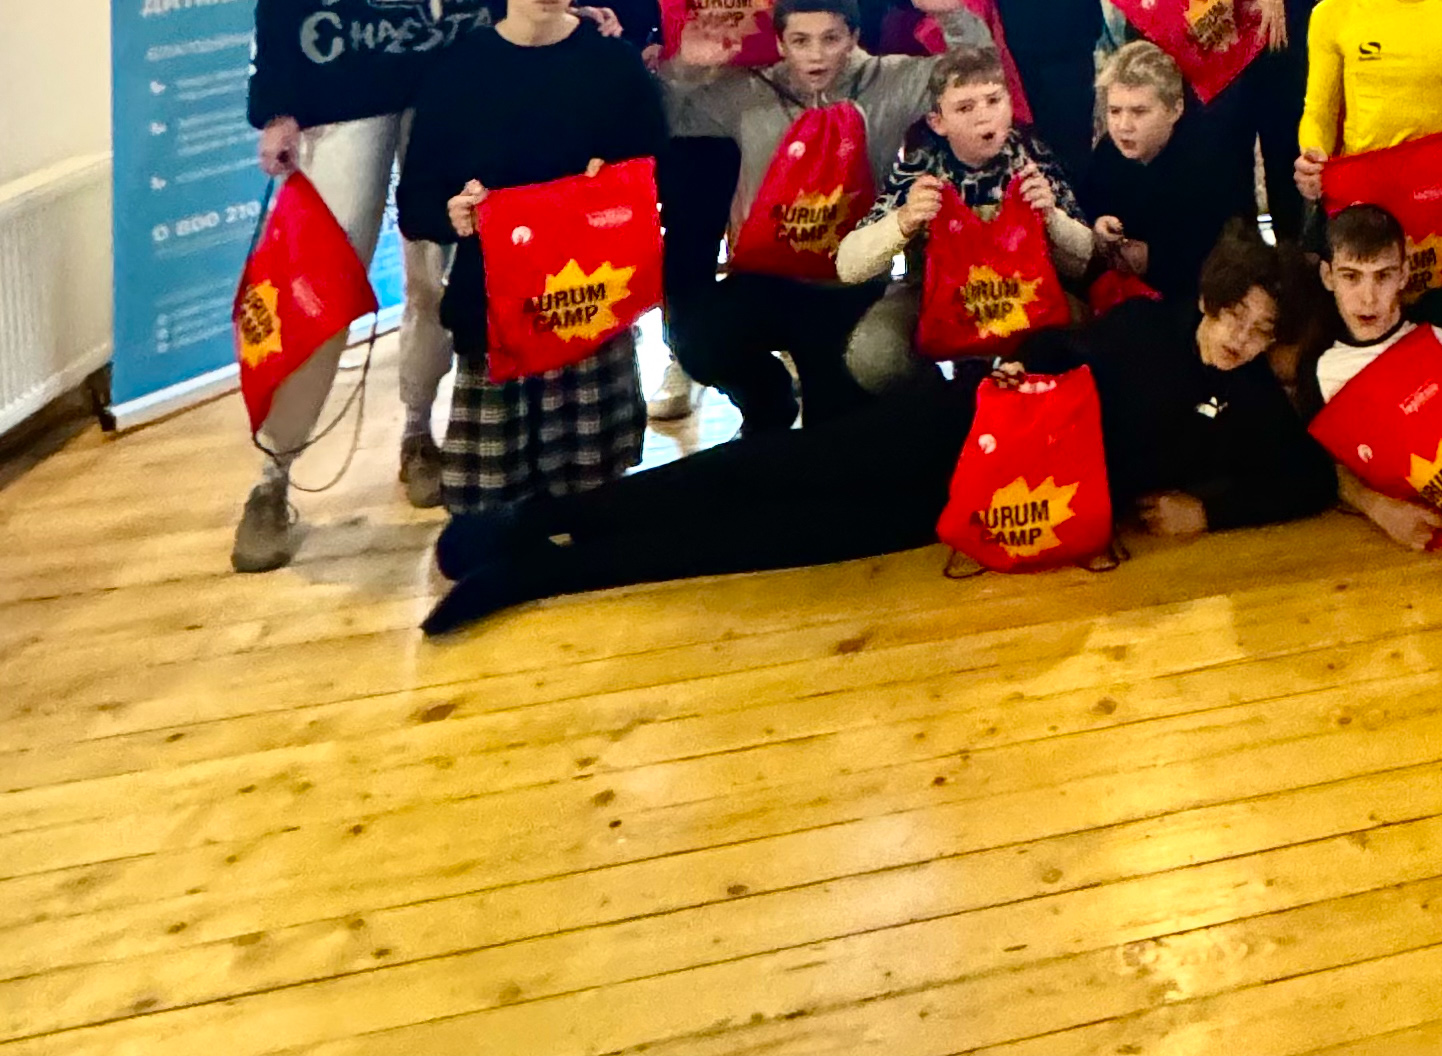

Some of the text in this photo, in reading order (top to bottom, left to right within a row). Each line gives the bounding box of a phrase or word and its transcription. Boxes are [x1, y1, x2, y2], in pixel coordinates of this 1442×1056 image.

[175, 211, 220, 237] 800
[523, 282, 606, 314] AURUM
[533, 304, 598, 333] CAMP
[969, 499, 1049, 529] AURUM
[981, 527, 1042, 547] CAMP
